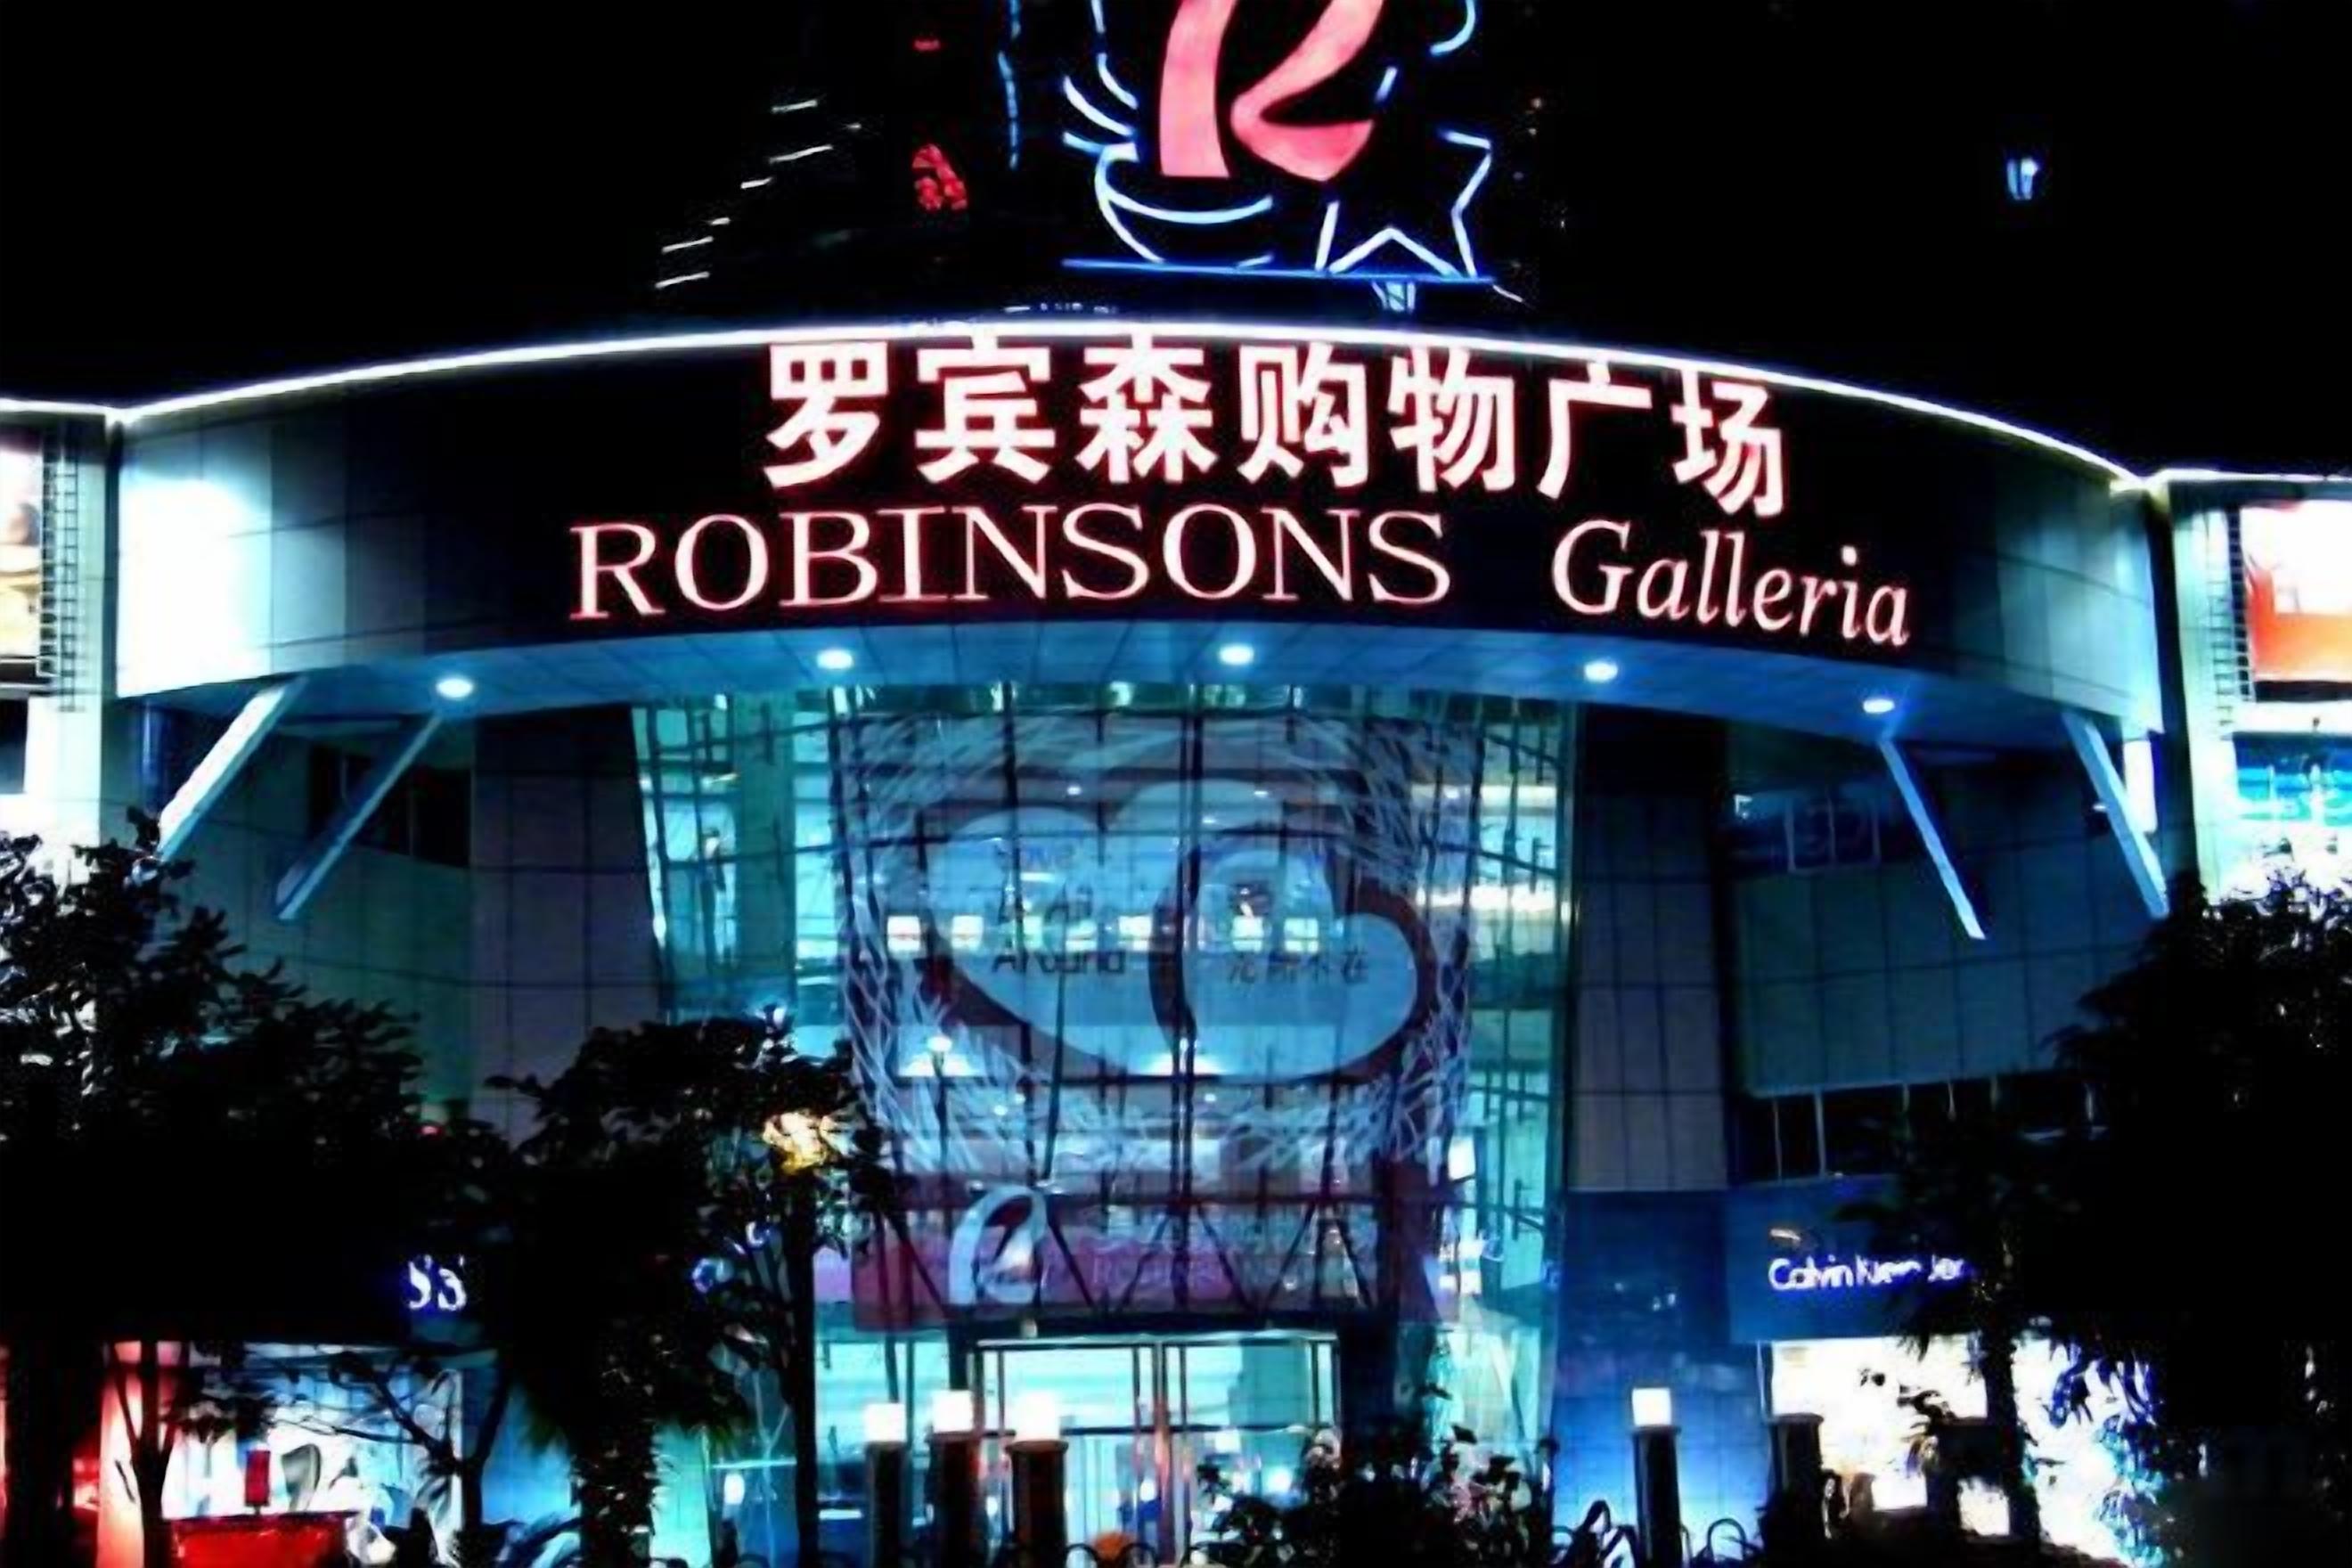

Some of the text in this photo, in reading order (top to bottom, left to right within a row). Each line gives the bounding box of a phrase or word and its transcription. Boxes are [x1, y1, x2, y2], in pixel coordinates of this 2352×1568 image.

[764, 333, 1784, 517] 罗宾森购物广场
[569, 502, 1911, 647] ROBINSONS Galleria
